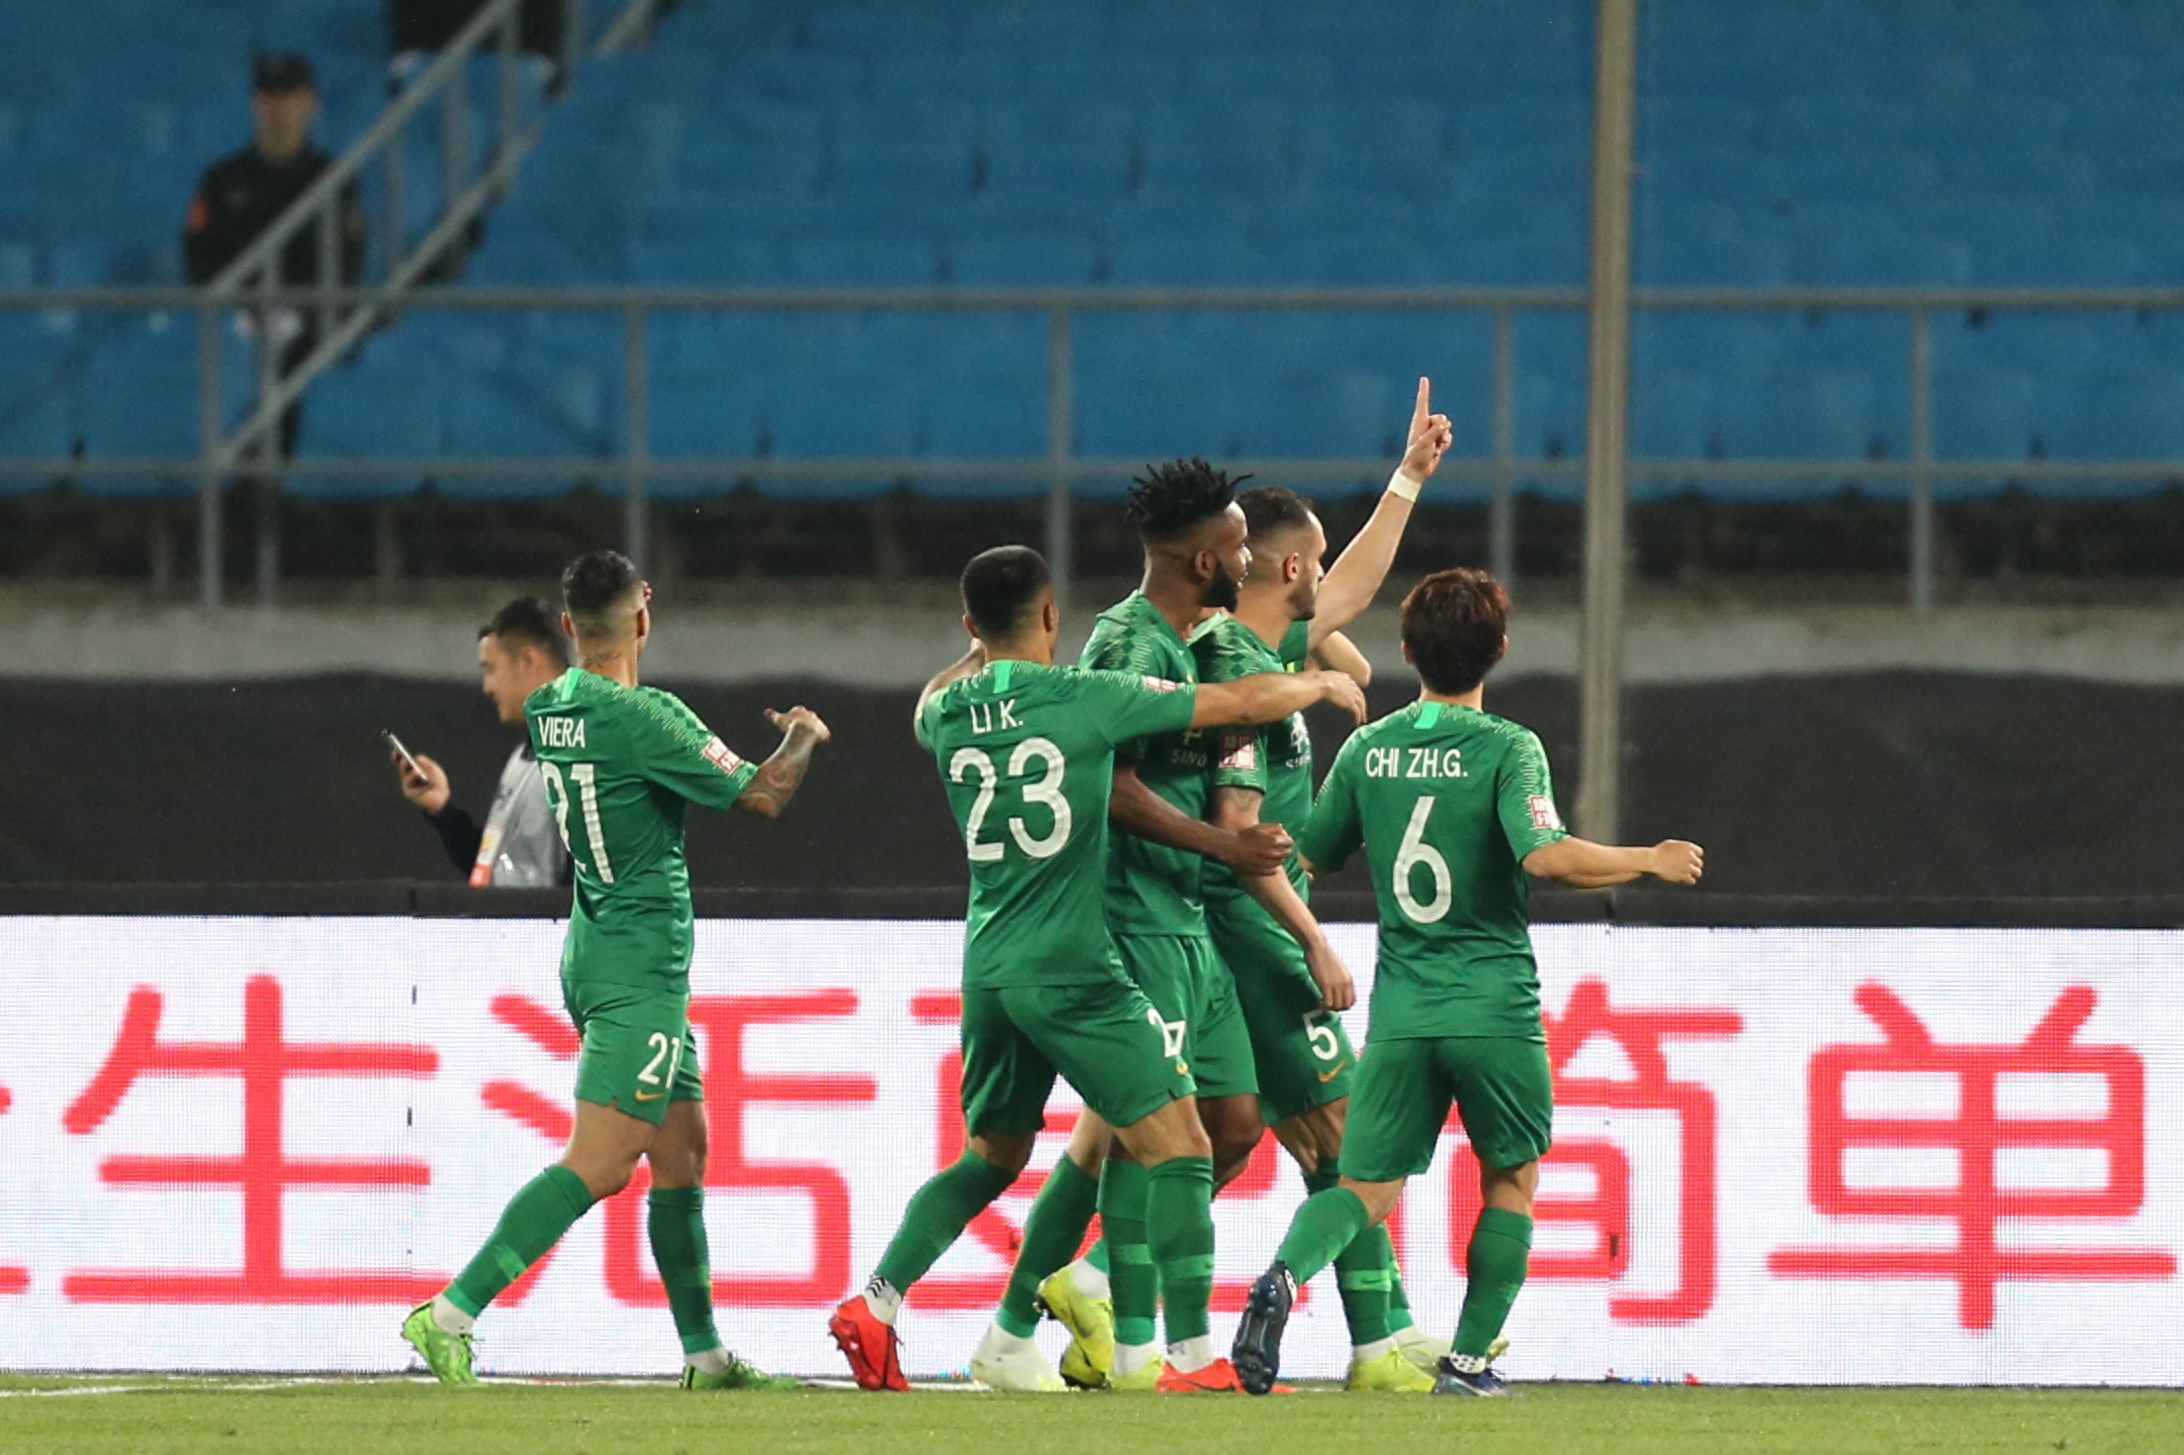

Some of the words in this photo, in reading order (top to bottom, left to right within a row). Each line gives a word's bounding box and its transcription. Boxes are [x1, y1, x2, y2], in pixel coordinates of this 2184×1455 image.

[537, 716, 587, 749] VIERA
[970, 703, 992, 734] LI
[1000, 698, 1024, 729] K.
[1365, 747, 1399, 779] CHI
[1405, 747, 1469, 779] ZH.G.
[948, 736, 1073, 862] 23
[1392, 796, 1453, 925] 6
[636, 1031, 681, 1089] 21
[1302, 1009, 1339, 1061] 5
[0, 974, 2178, 1332] 生活简单
